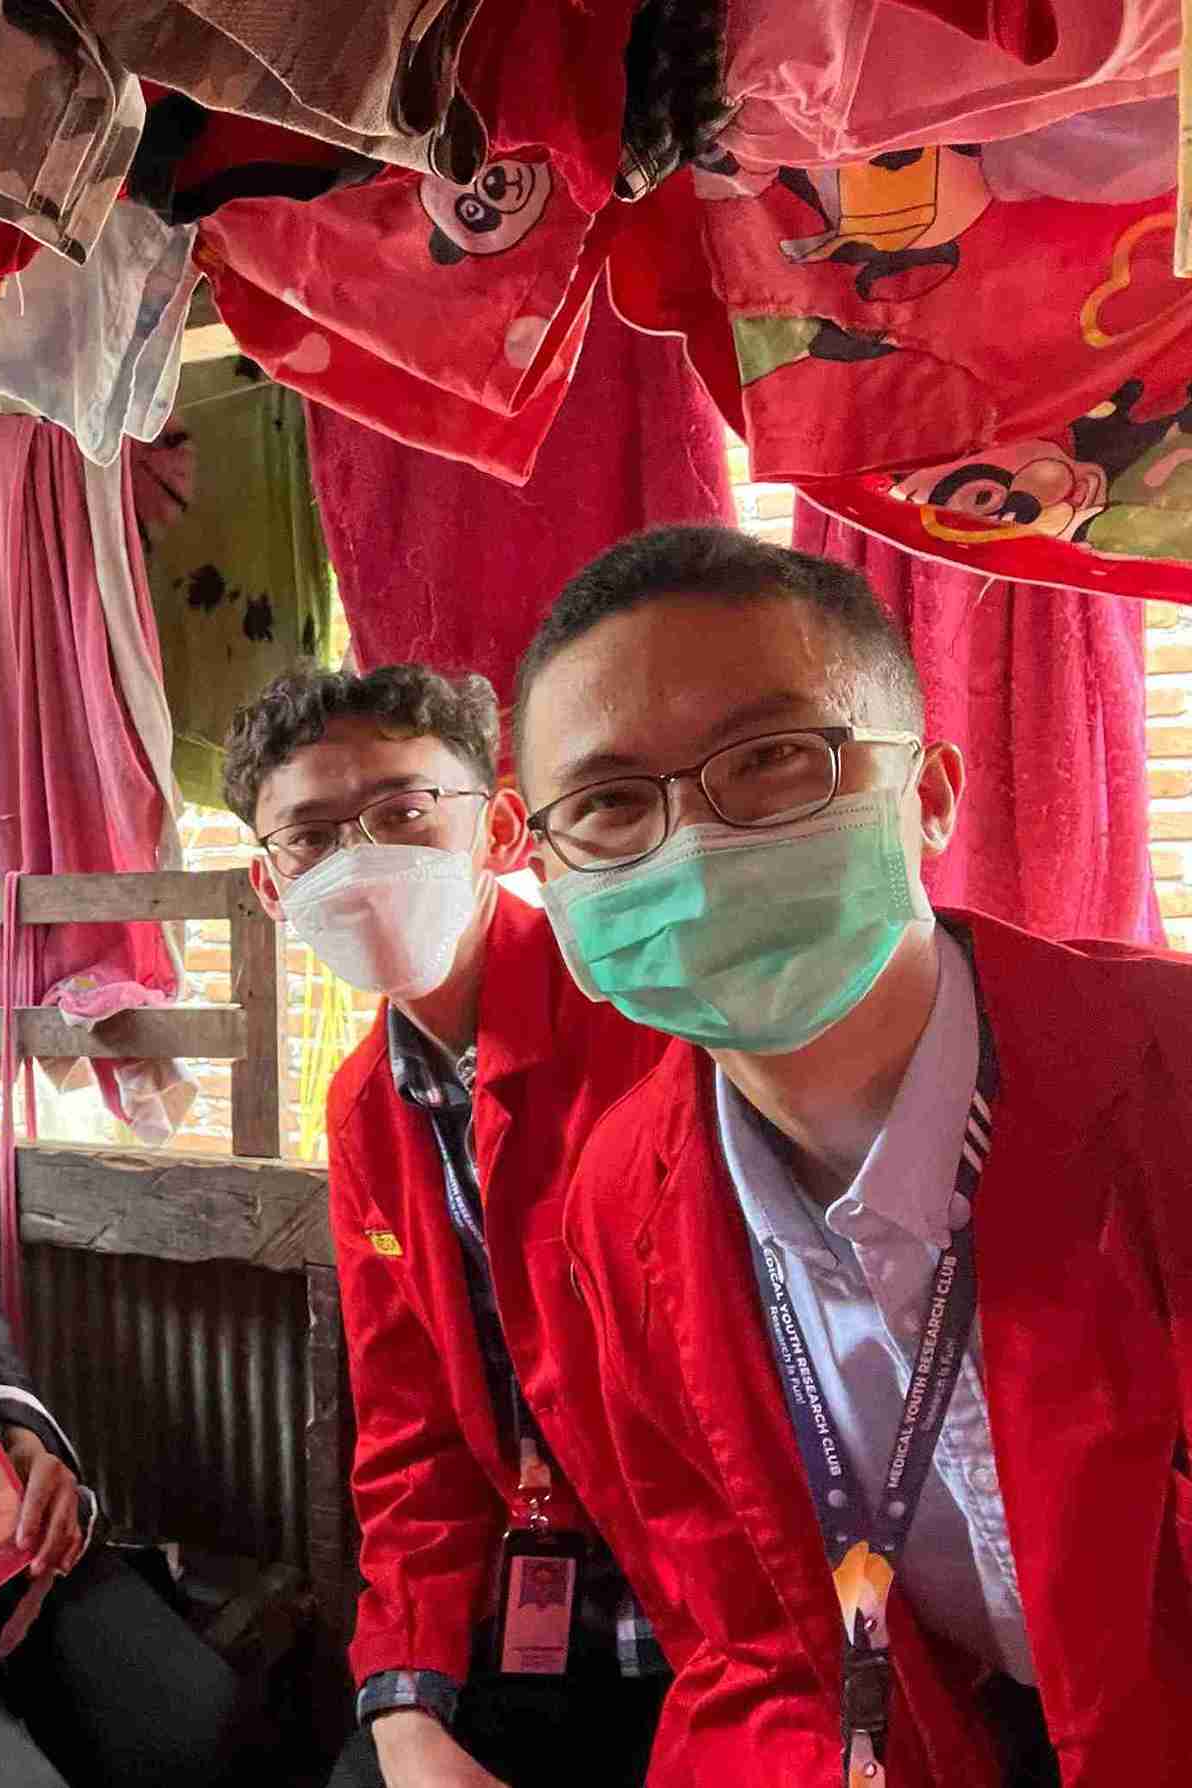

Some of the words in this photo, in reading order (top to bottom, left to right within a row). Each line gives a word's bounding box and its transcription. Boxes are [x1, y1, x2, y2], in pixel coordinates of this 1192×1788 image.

[779, 1303, 803, 1355] YOUTH
[797, 1357, 830, 1435] RESEARCH
[822, 1437, 842, 1477] CLUB
[887, 1424, 914, 1488] MEDICAL
[903, 1376, 927, 1424] YOUTH
[918, 1297, 947, 1374] RESEARCH
[936, 1255, 958, 1295] CLUB
